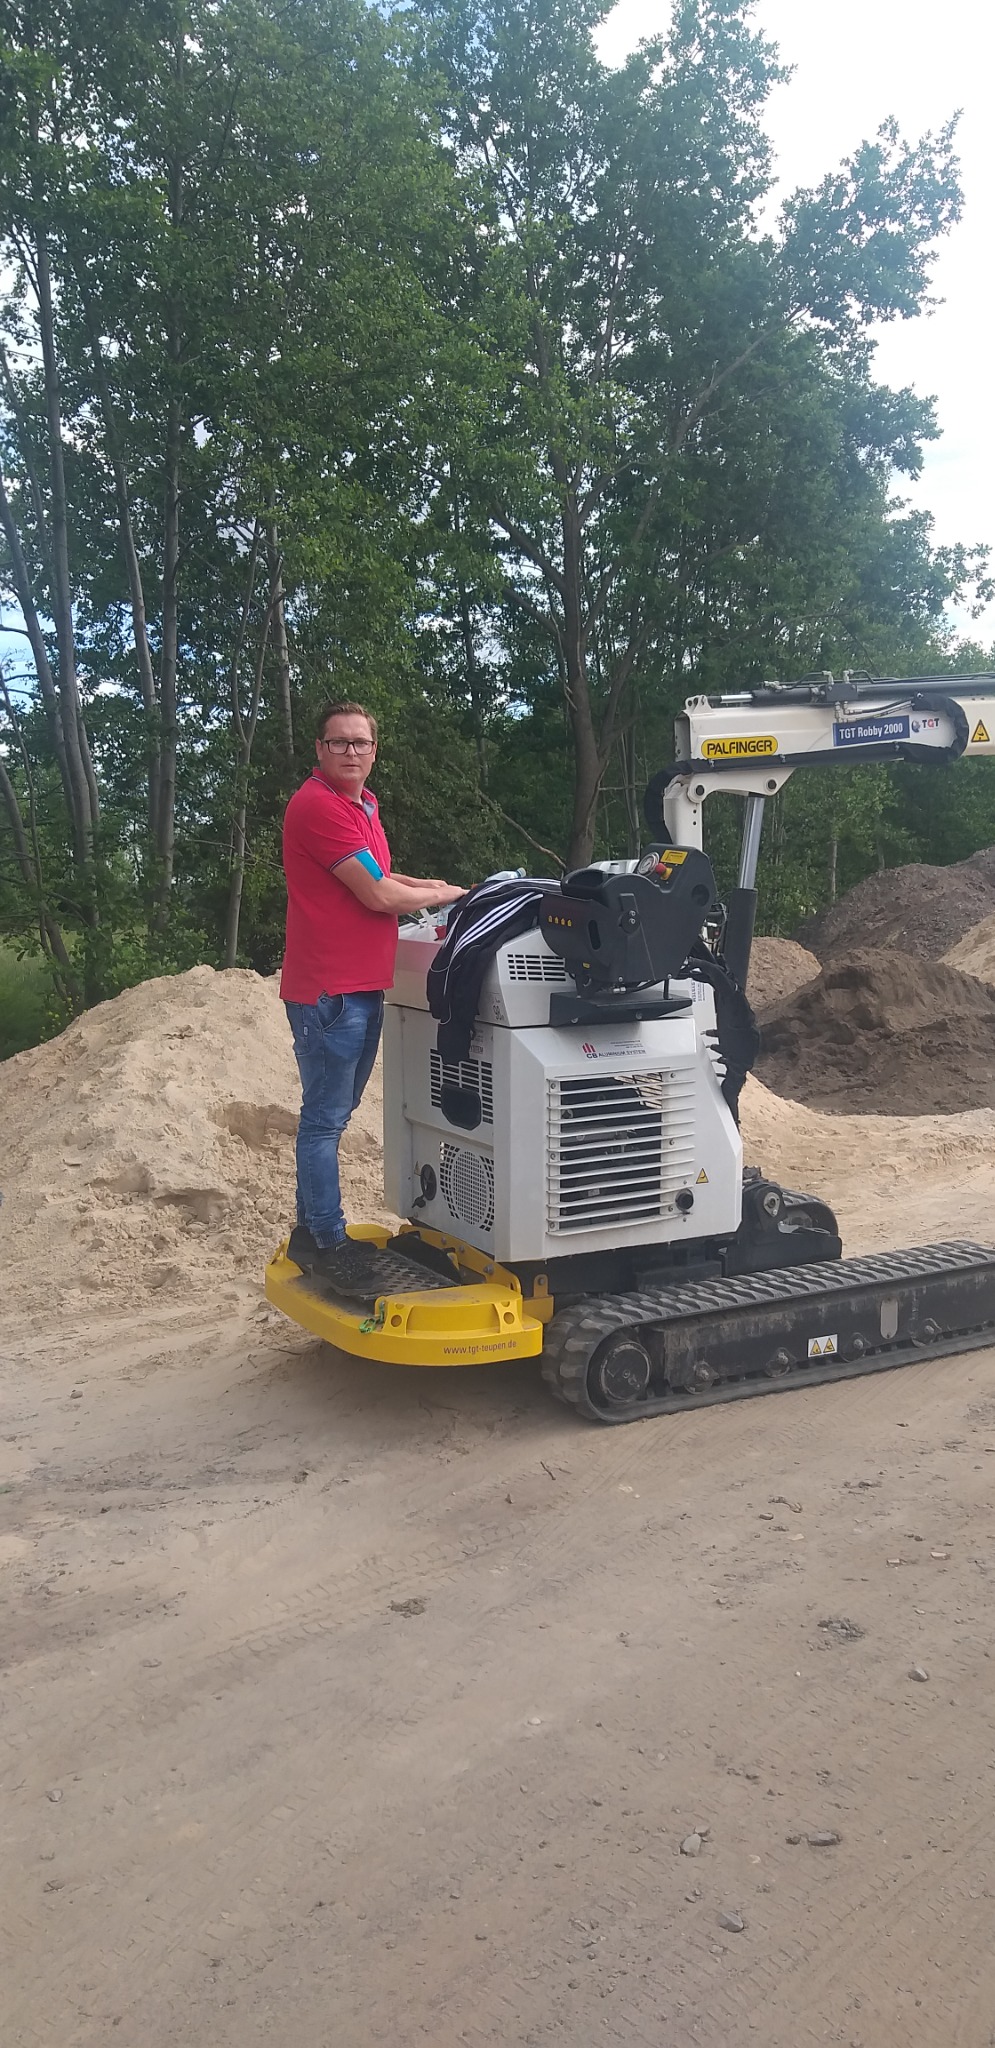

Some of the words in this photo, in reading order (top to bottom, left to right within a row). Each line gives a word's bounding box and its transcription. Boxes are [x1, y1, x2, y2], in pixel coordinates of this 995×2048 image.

[839, 727, 856, 739] TGT
[858, 725, 883, 737] Robby
[884, 723, 903, 734] 2000
[922, 718, 940, 729] TGT
[707, 740, 773, 755] PALFINGER
